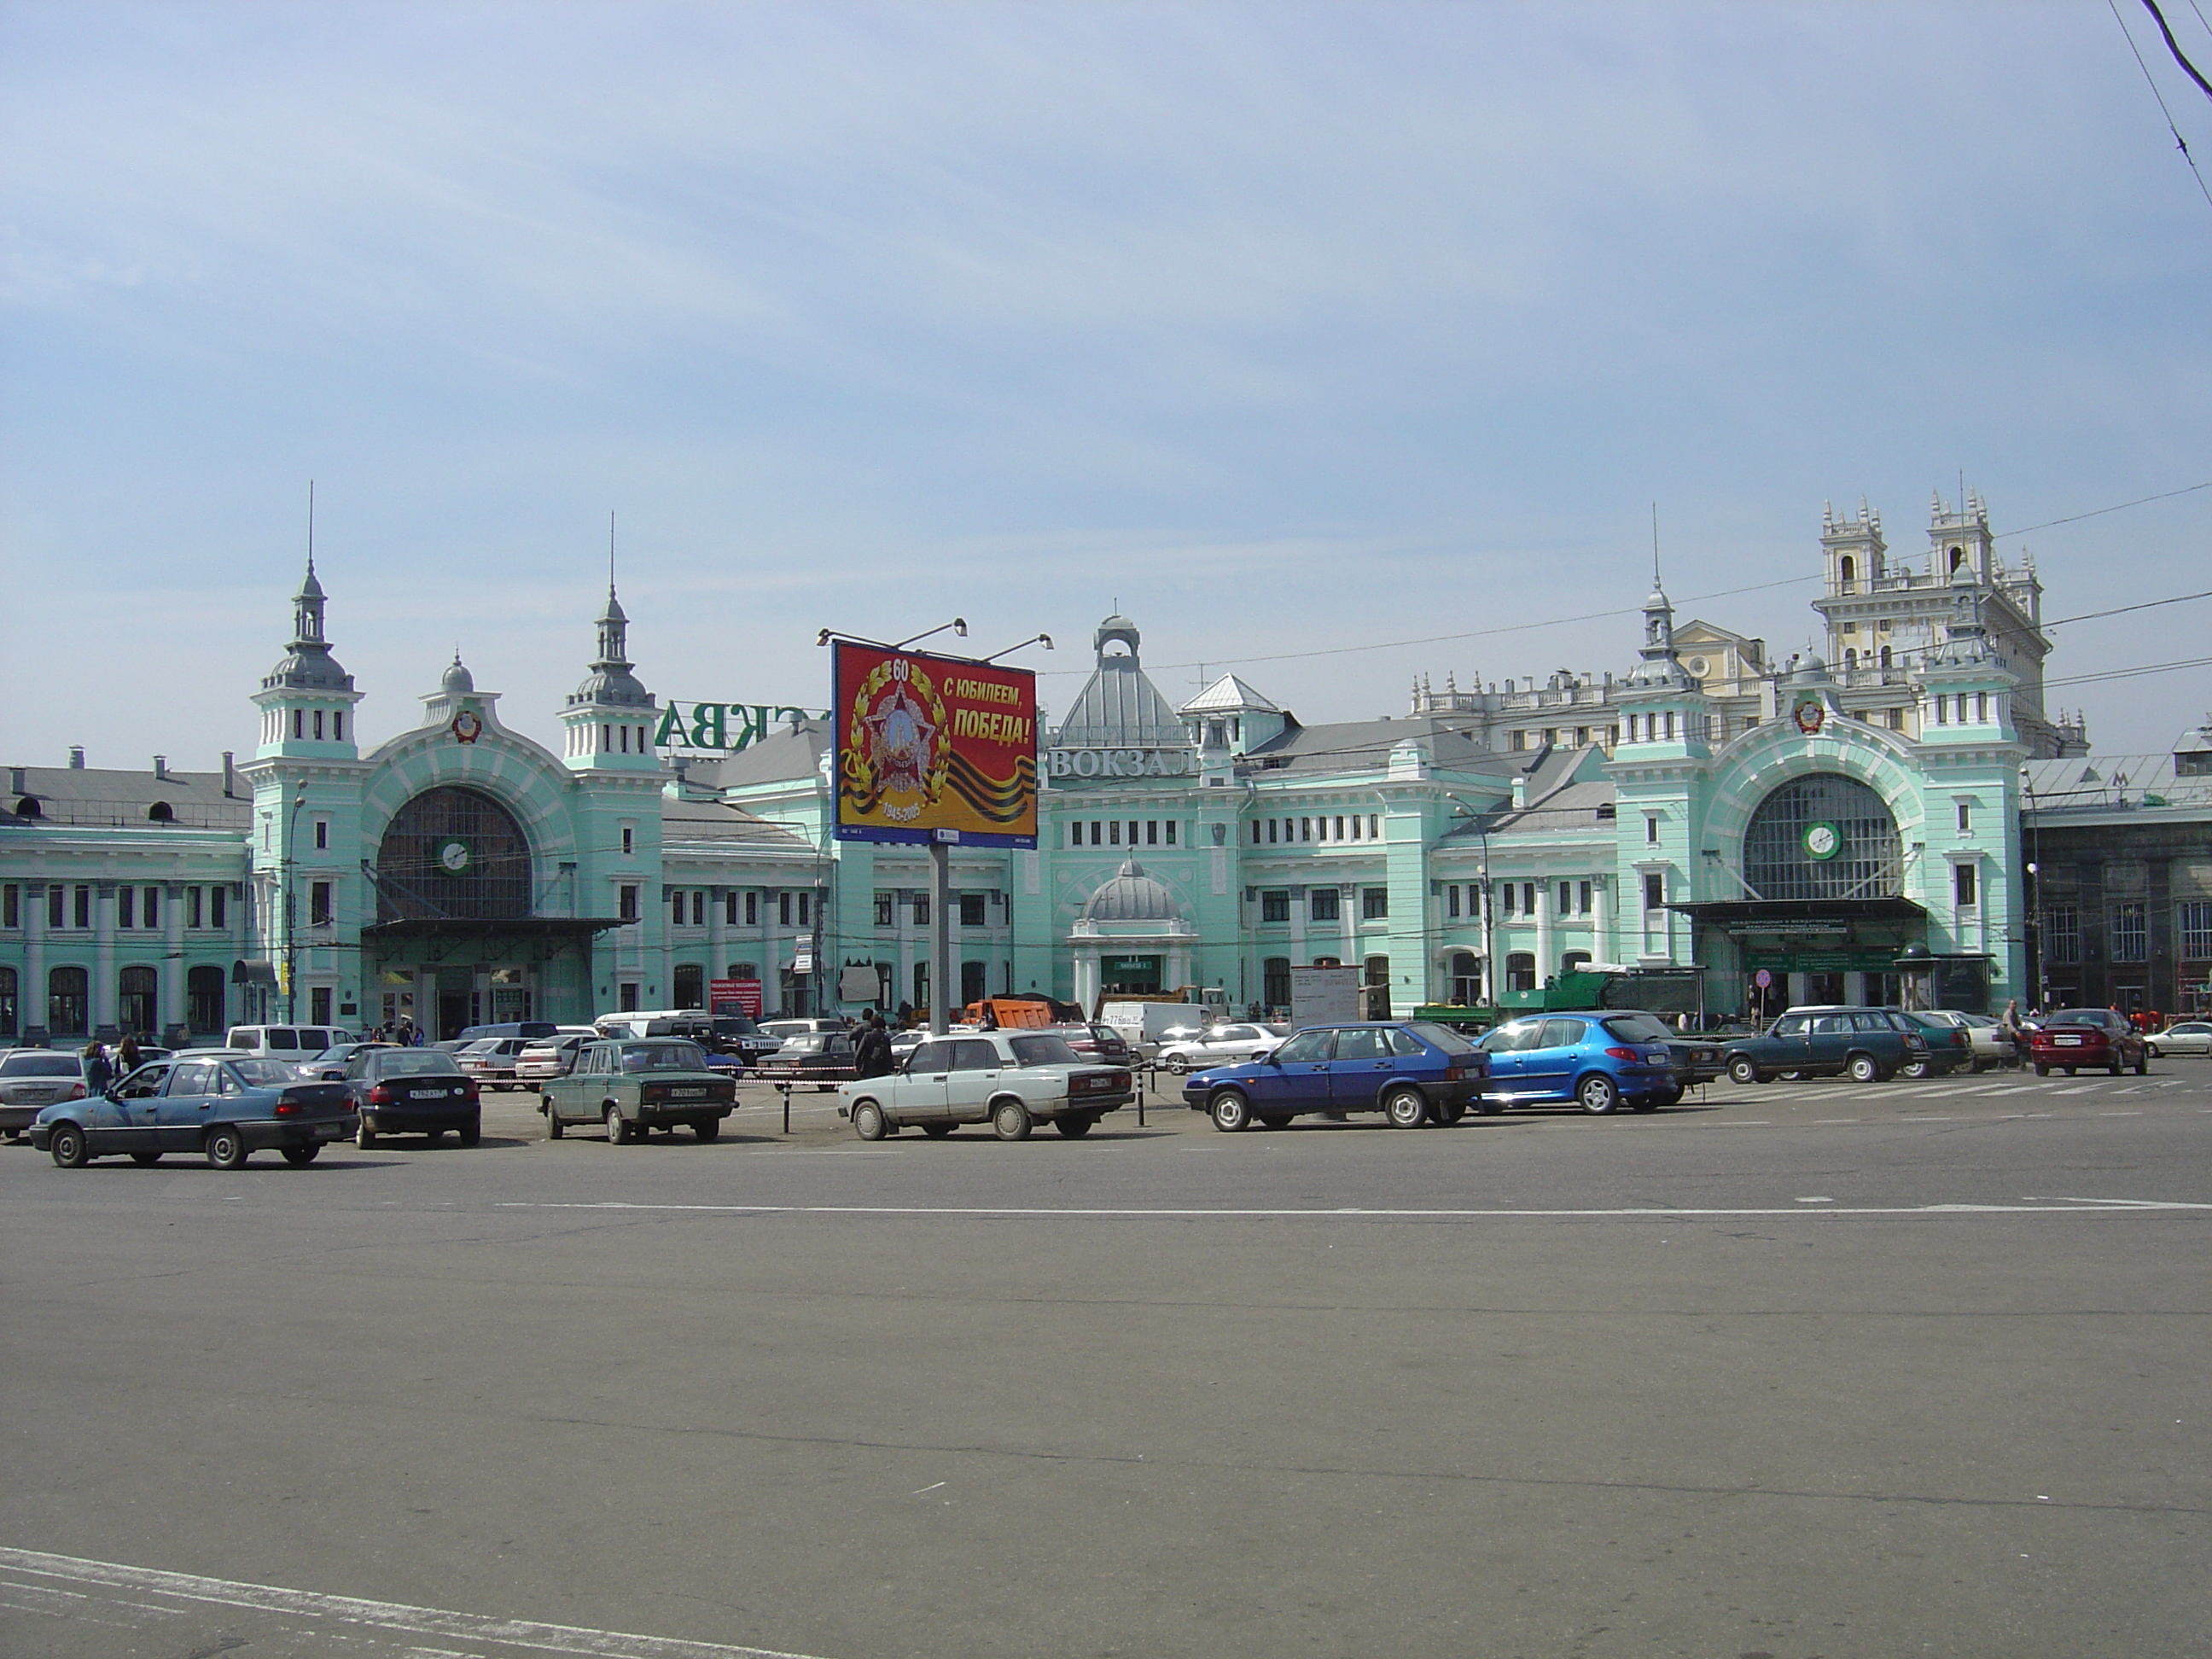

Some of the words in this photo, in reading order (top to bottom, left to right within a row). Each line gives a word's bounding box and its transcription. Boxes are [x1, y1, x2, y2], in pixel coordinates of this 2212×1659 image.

[893, 659, 909, 682] 60
[944, 678, 953, 696] С
[956, 679, 1022, 710] ЮБИЛЕЕМ,
[953, 709, 1031, 748] ПОБЕДА!
[1049, 749, 1201, 777] ВОКЗАЛ
[883, 801, 921, 822] 1945-2005
